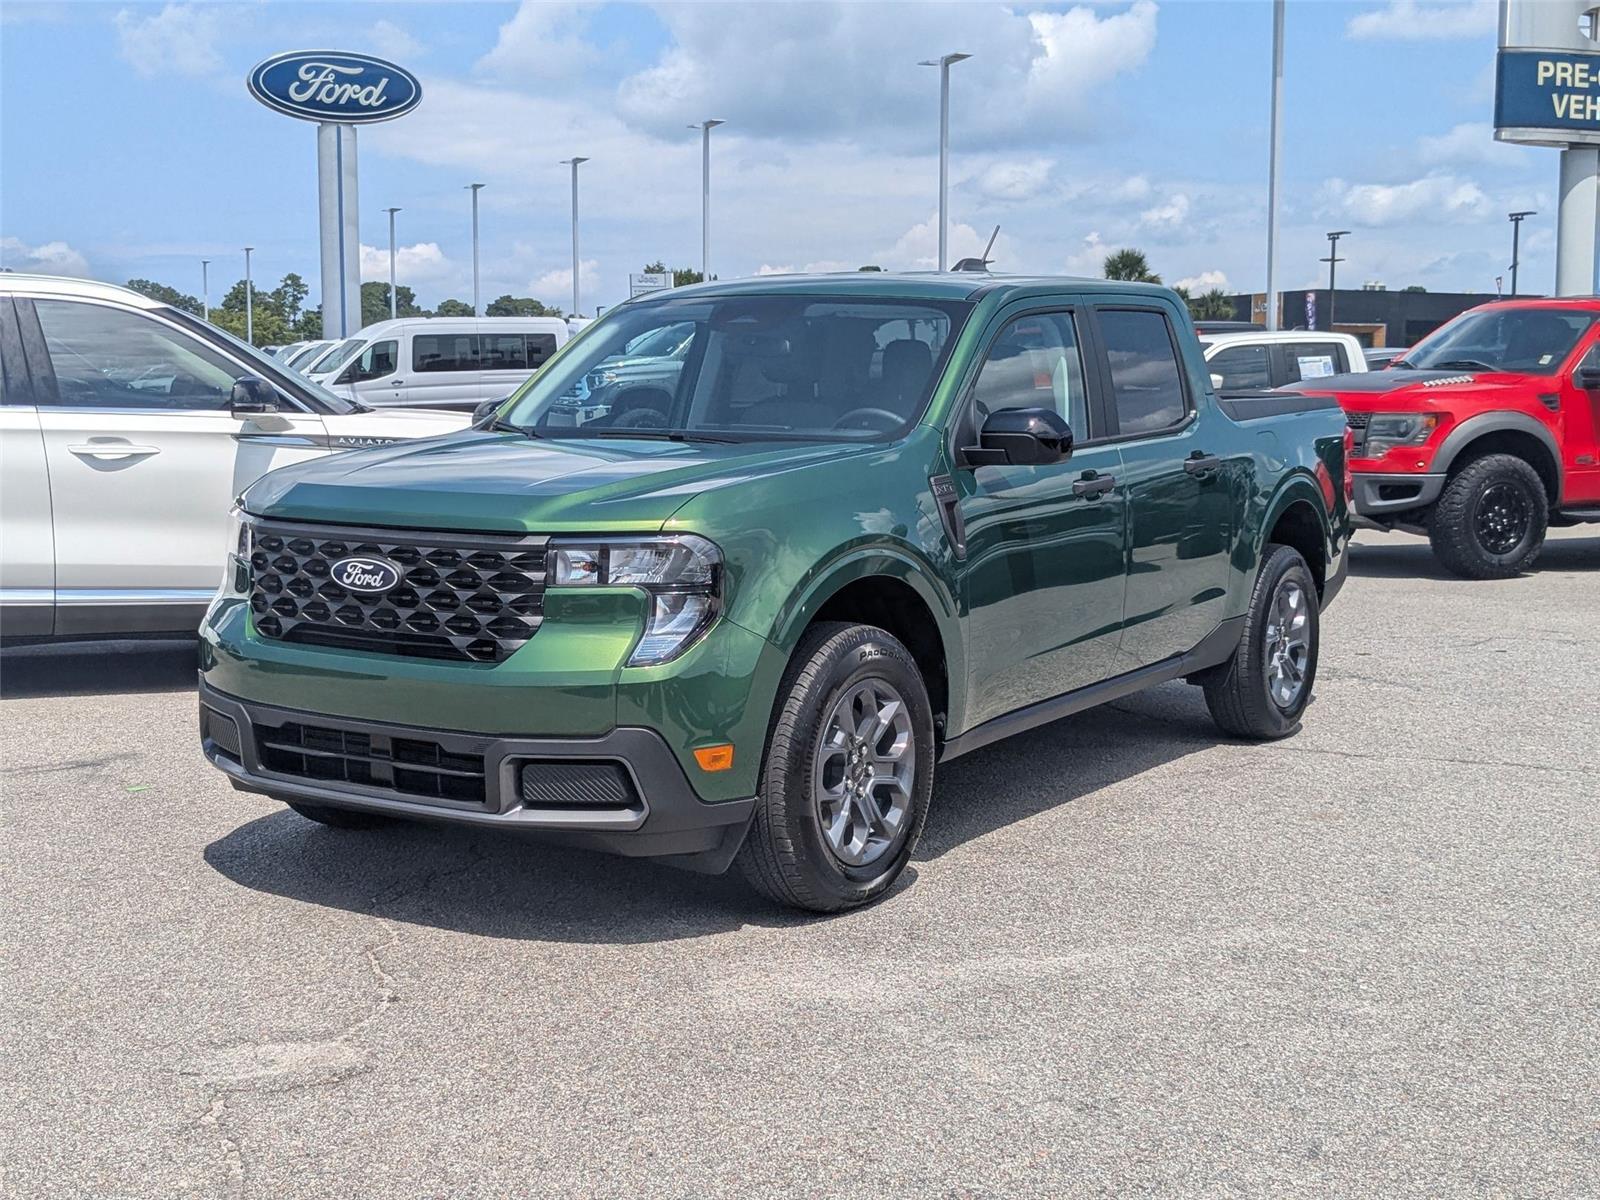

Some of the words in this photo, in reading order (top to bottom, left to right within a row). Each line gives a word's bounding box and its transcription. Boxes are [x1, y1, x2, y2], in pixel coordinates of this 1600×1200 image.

[288, 62, 390, 107] Ford
[1537, 60, 1600, 88] PRE-
[339, 437, 399, 445] AVIATO
[342, 562, 384, 587] Ford
